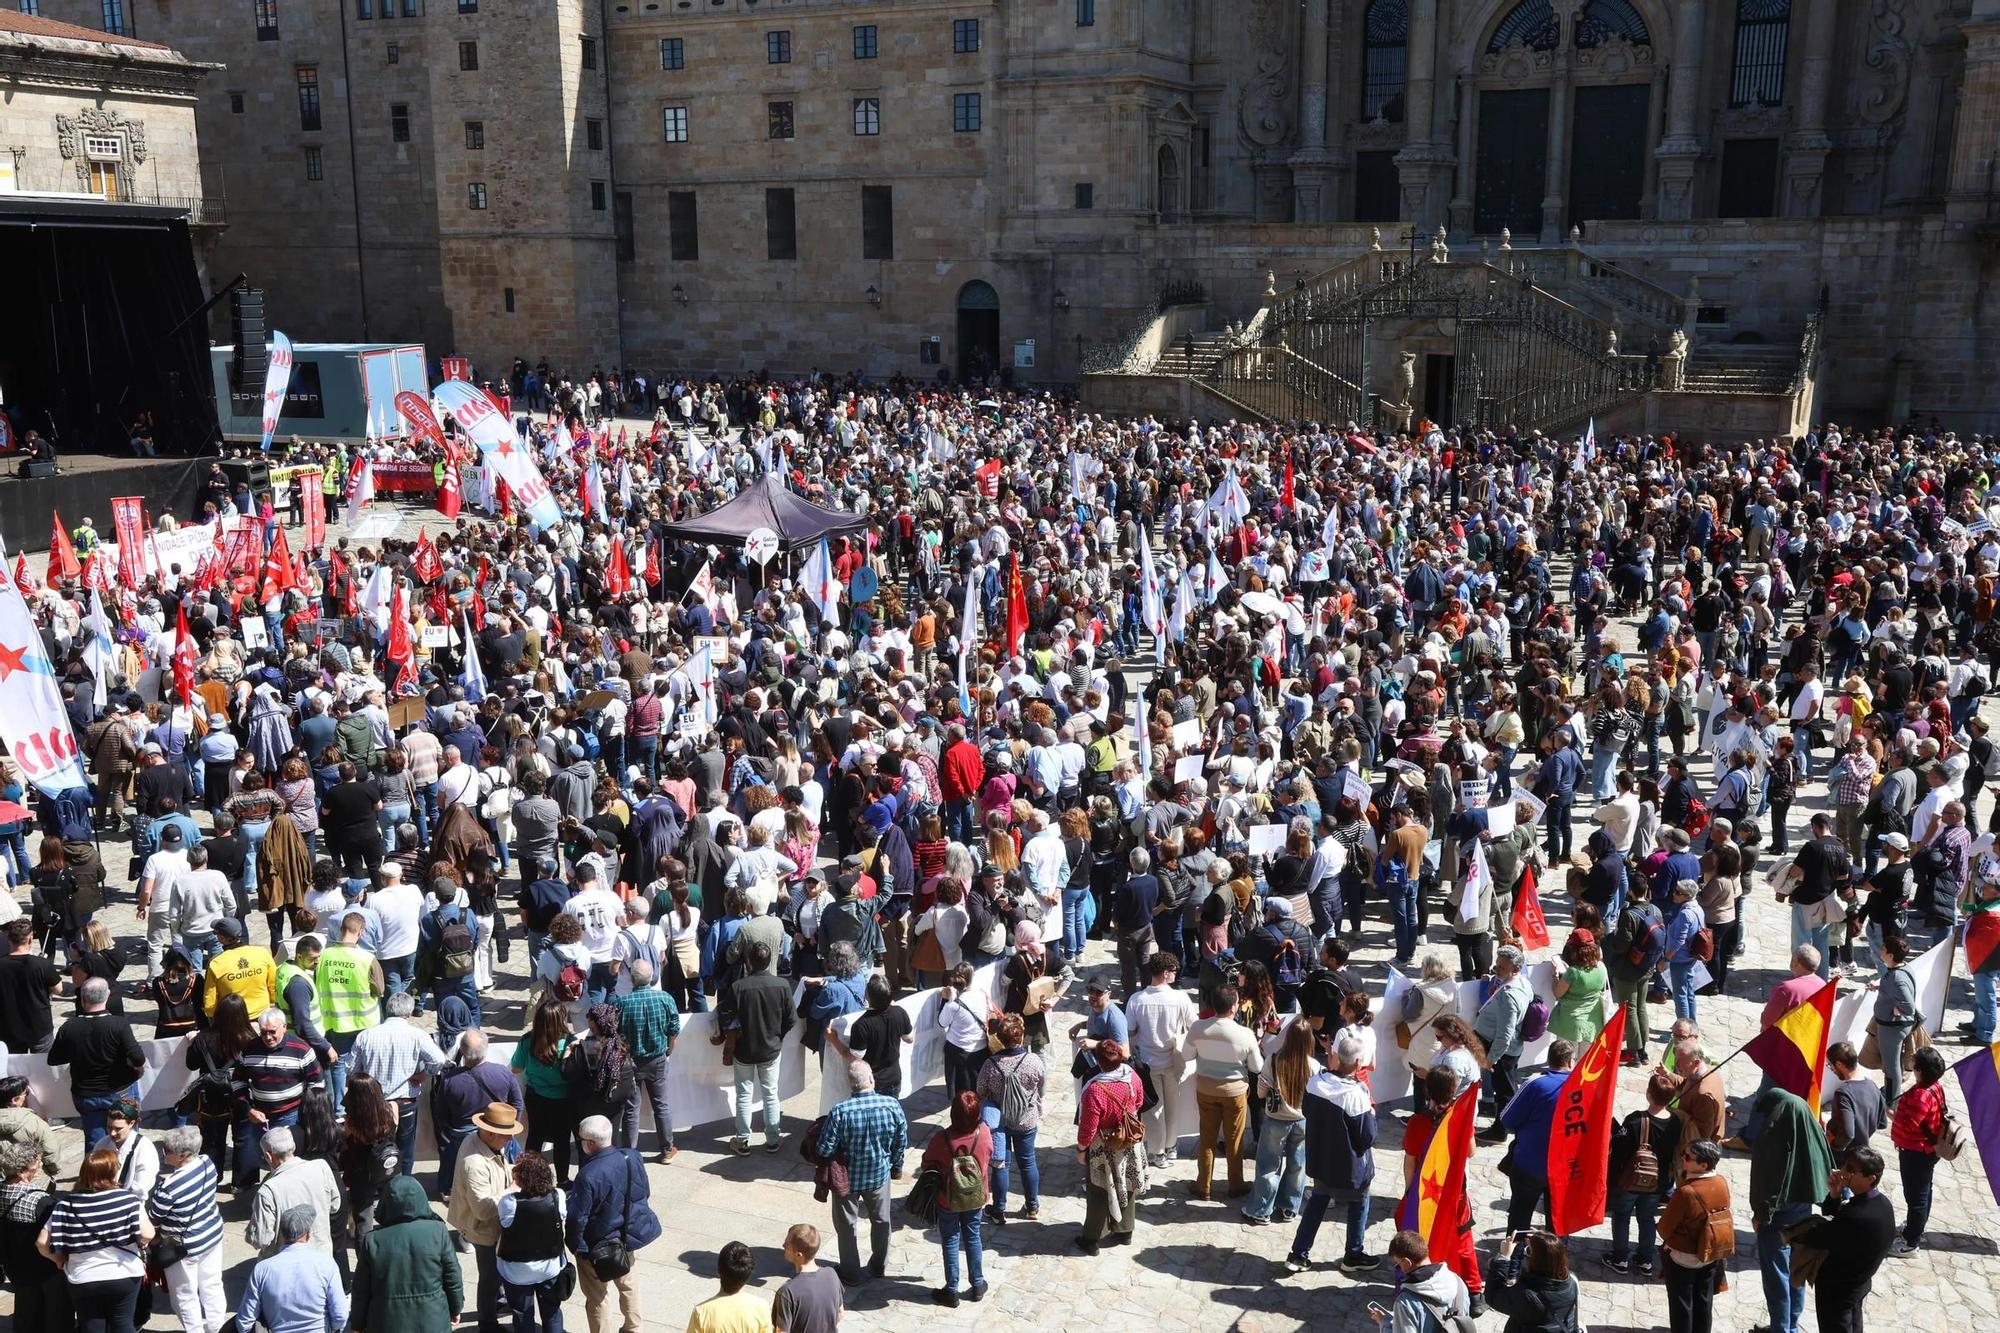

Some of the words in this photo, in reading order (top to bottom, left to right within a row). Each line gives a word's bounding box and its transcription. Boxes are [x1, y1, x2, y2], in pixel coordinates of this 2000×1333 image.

[148, 536, 186, 554] SNIDADE
[683, 715, 695, 723] EU
[324, 960, 356, 968] SERVIZO
[227, 968, 262, 981] Galicia
[1564, 1089, 1587, 1136] PCE
